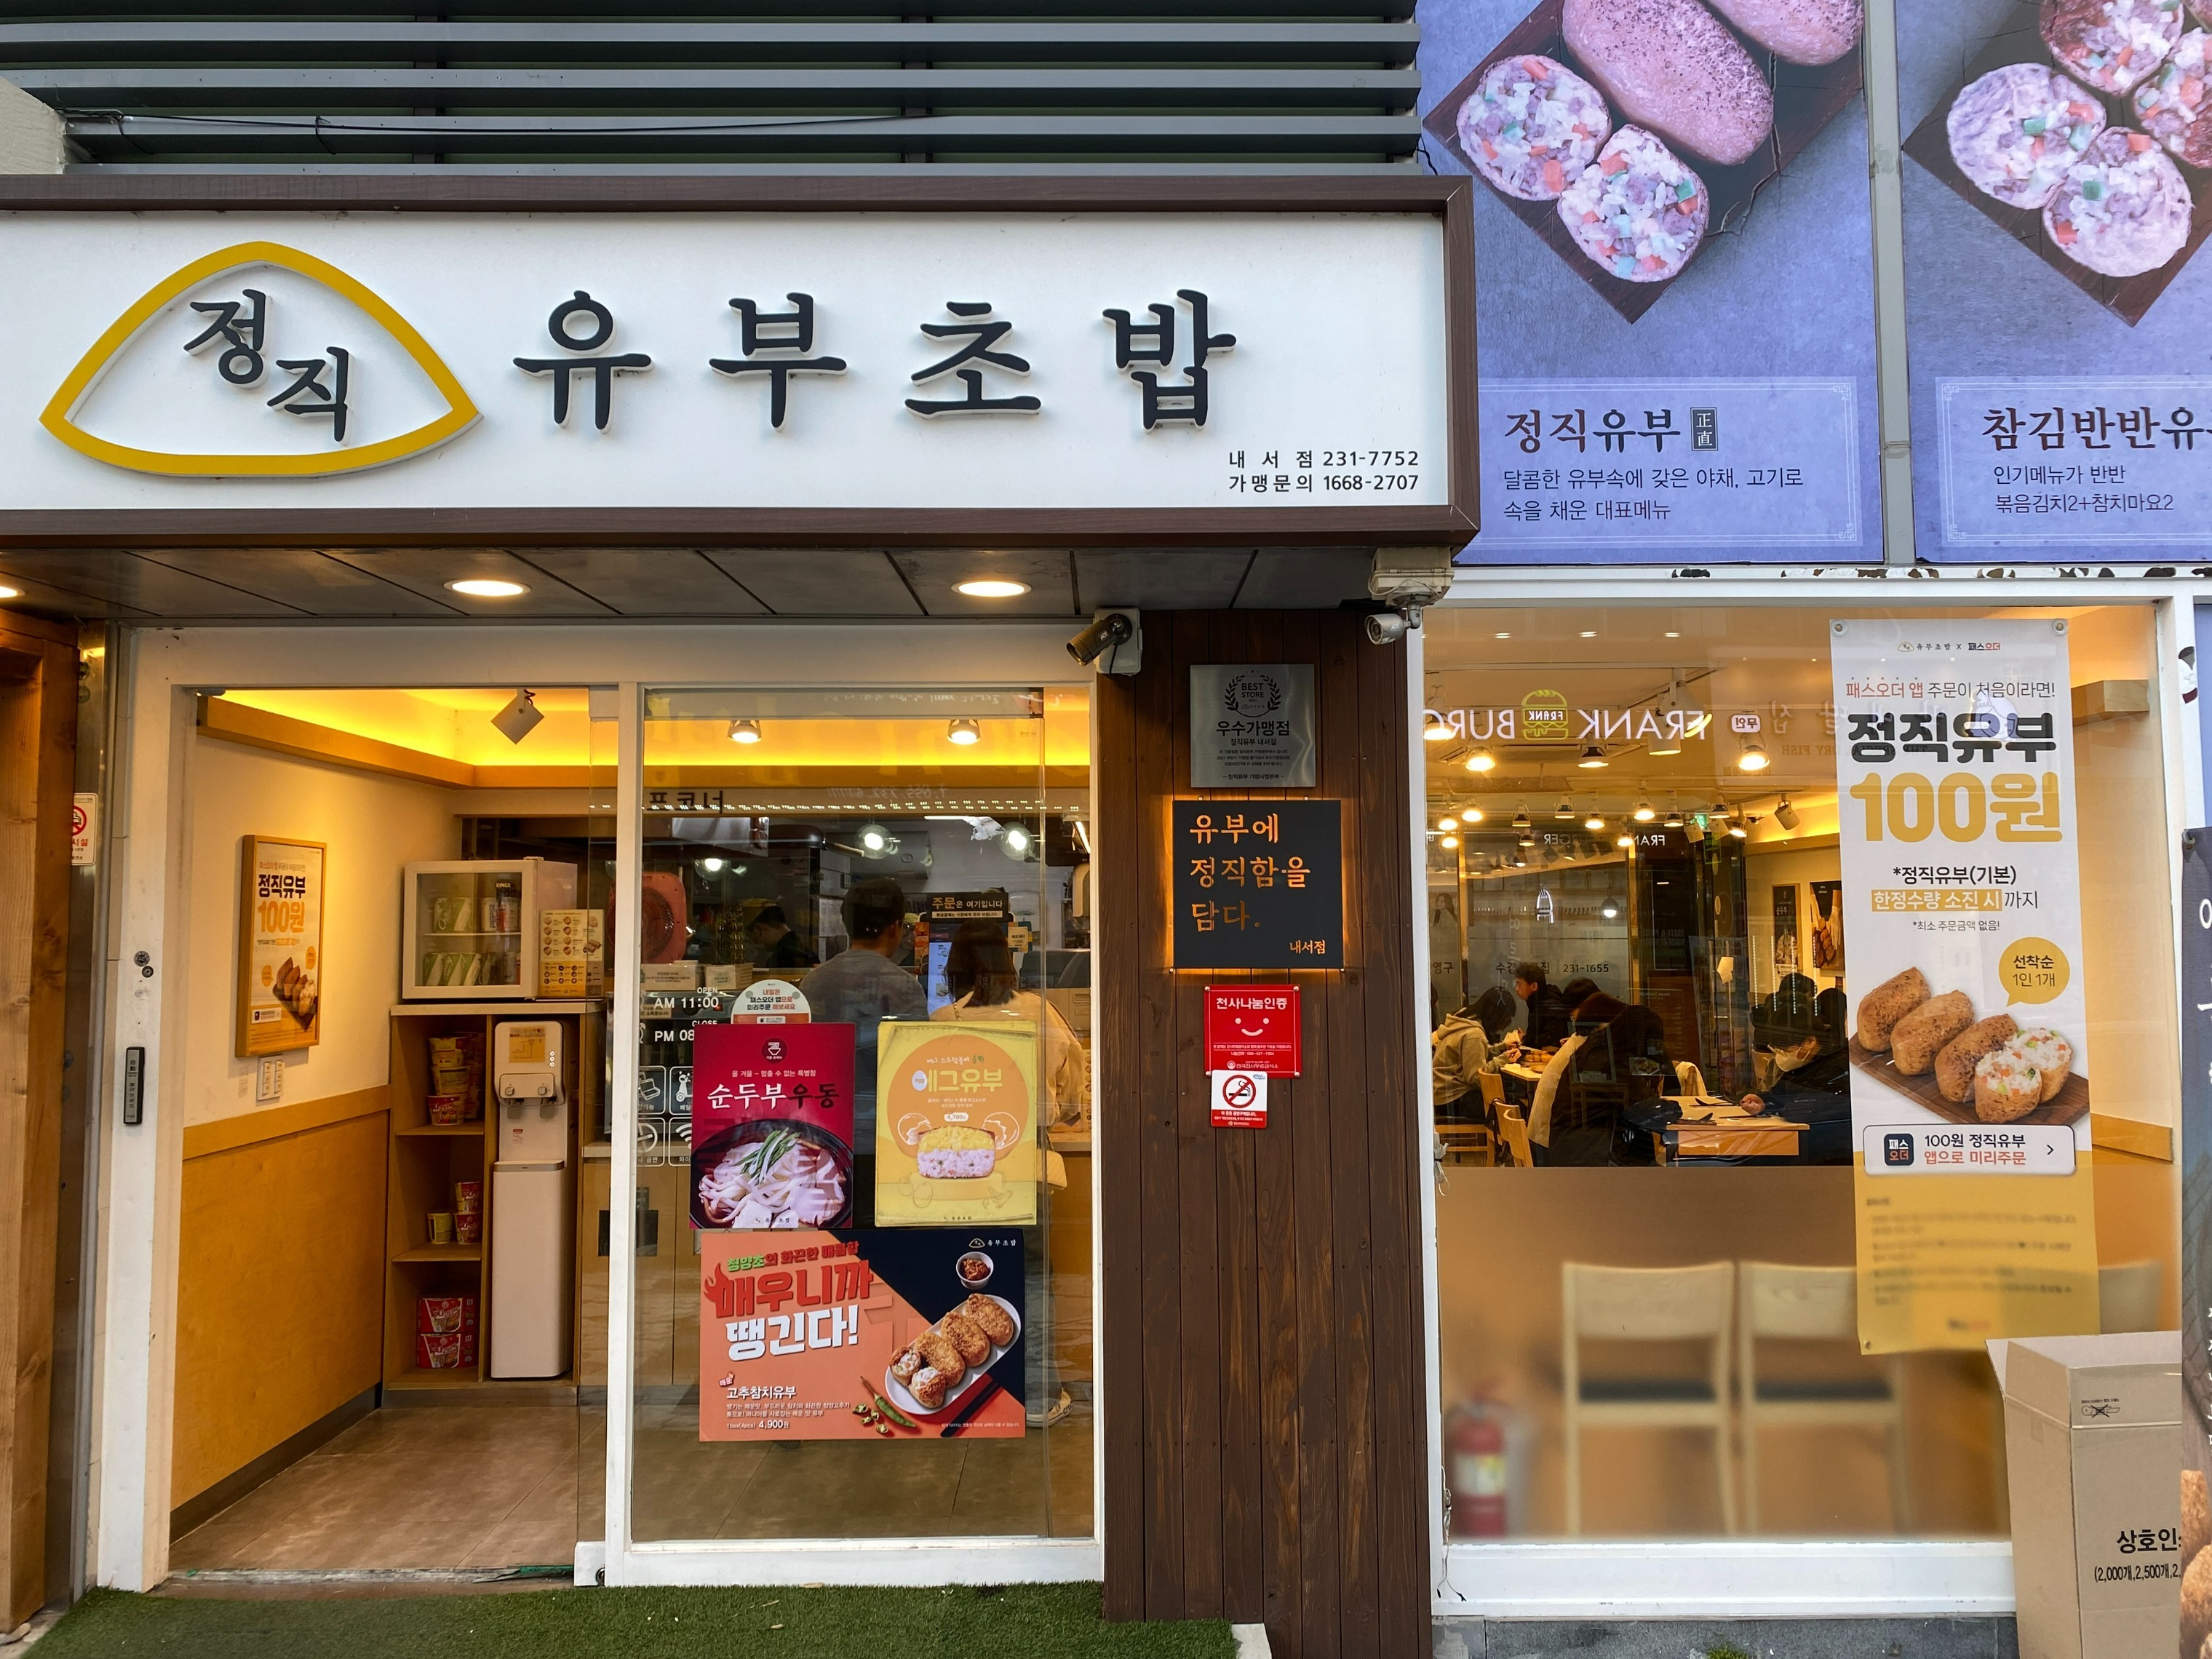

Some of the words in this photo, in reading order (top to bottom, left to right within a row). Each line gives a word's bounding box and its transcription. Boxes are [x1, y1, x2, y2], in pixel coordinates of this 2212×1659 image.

[183, 288, 349, 442] 정직
[512, 289, 1236, 432] 유부초밥
[1504, 408, 1681, 453] 정직유부
[1695, 411, 1713, 447] 正直
[1982, 406, 2212, 451] 참김반반유
[1323, 450, 1419, 466] 231-7752
[1229, 474, 1313, 493] 가맹문의
[1323, 474, 1419, 490] 1668-2707
[1503, 469, 1561, 490] 달콤한
[1567, 468, 1644, 490] 유부속에
[1651, 468, 1690, 489] 갖은
[1695, 467, 1739, 489] 야채,
[1746, 466, 1804, 487] 고기로
[1994, 466, 2084, 485] 인기메뉴가
[2090, 465, 2126, 484] 반반
[1503, 500, 1542, 522] 속을
[1549, 500, 1588, 521] 채운
[1596, 500, 1671, 520] 대표메뉴
[1995, 493, 2174, 514] 볶음김치2+참치마요2
[1916, 642, 1951, 651] 유부초밥
[1968, 642, 2001, 651] 패스오더
[1241, 683, 1264, 691] BEST
[1845, 682, 1905, 699] 패스오더
[1909, 683, 1923, 699] 앱
[1927, 682, 1971, 698] 주문이
[1976, 681, 2056, 699] 처음이라면!
[1216, 720, 1291, 737] 우수가맹점
[1847, 712, 2057, 764] 정직유부
[1230, 738, 1255, 747] 정직유부
[1257, 738, 1277, 747] 내서점
[1849, 771, 2064, 843] 100원
[1189, 813, 1279, 845] 유부에
[1190, 856, 1311, 888] 정직함을
[258, 873, 306, 899] 정직유부
[931, 896, 963, 910] 주문은
[966, 899, 1003, 909] 여기입니다
[1874, 891, 1941, 910] 한정수량
[1944, 891, 1978, 910] 소진
[1983, 890, 2000, 910] 시
[2004, 890, 2039, 910] 까지
[258, 900, 305, 934] 100원
[1191, 900, 1261, 932] 담다.
[1938, 920, 1976, 931] 주문금액
[1978, 920, 2000, 931] 없음!
[1289, 939, 1326, 955] 내서점
[1562, 963, 1610, 974] 231-1655
[2013, 955, 2055, 969] 선착순
[2012, 972, 2032, 987] 1인
[2034, 972, 2056, 987] 1개
[653, 997, 675, 1008] AM
[680, 997, 720, 1008] 11:00
[1216, 997, 1288, 1010] 천사나눔인증
[654, 1030, 675, 1042] PM
[1888, 1138, 1909, 1150] 패스
[1924, 1134, 1965, 1148] 100원
[1968, 1133, 2026, 1148] 정직유부
[1889, 1150, 1909, 1161] 오더
[1924, 1150, 1965, 1165] 앱으로
[1970, 1150, 2027, 1166] 미리주문
[727, 1252, 778, 1272] 청양초의
[781, 1246, 819, 1265] 화끈한
[710, 1260, 874, 1318] 매우니까
[725, 1304, 859, 1362] 땡긴다!
[726, 1385, 797, 1400] 고추참치유부
[758, 1420, 789, 1430] 4,900원
[2116, 1527, 2181, 1554] 상호인
